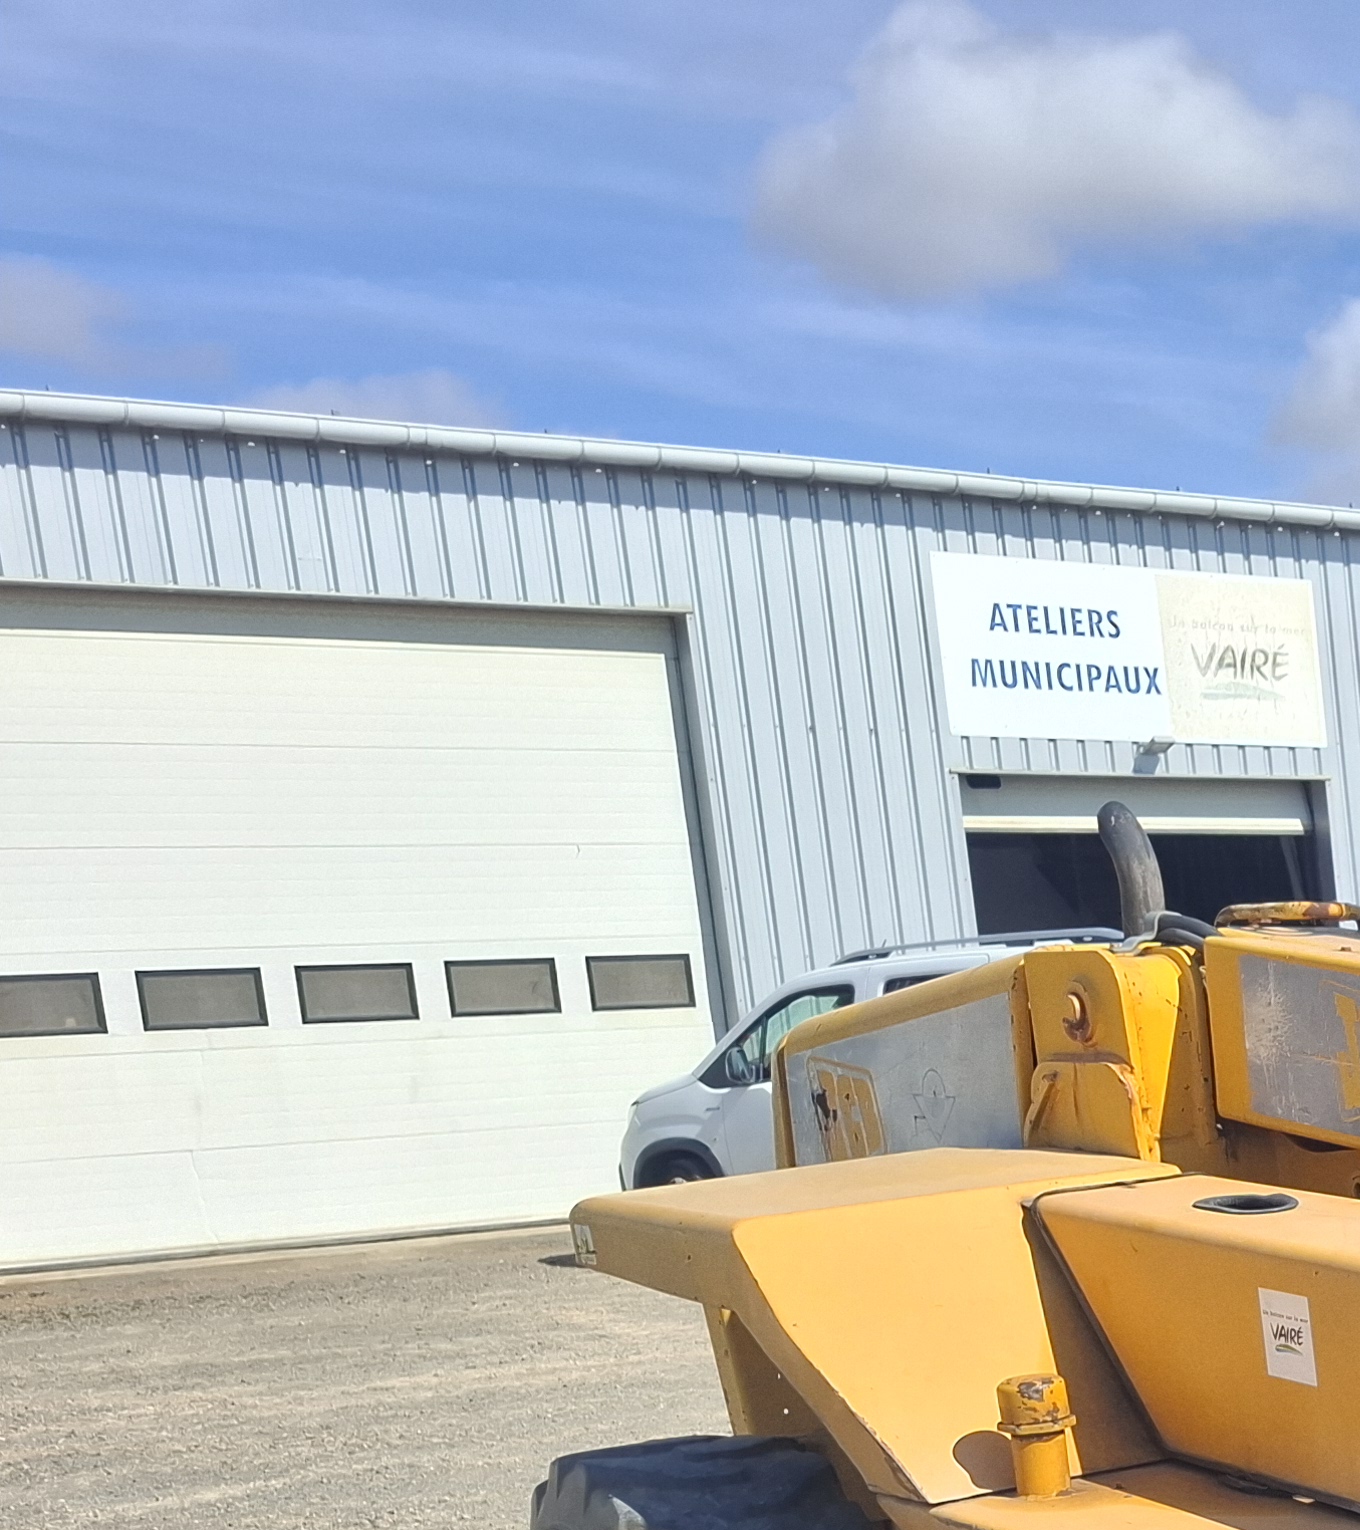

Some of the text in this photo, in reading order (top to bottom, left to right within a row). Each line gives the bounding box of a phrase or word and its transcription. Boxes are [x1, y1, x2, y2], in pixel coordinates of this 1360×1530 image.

[989, 602, 1121, 639] ATELIERS
[970, 657, 1162, 696] MUNICIPAUX
[1190, 642, 1290, 682] VAIRÉ
[1269, 1321, 1304, 1347] VAIRÉ
